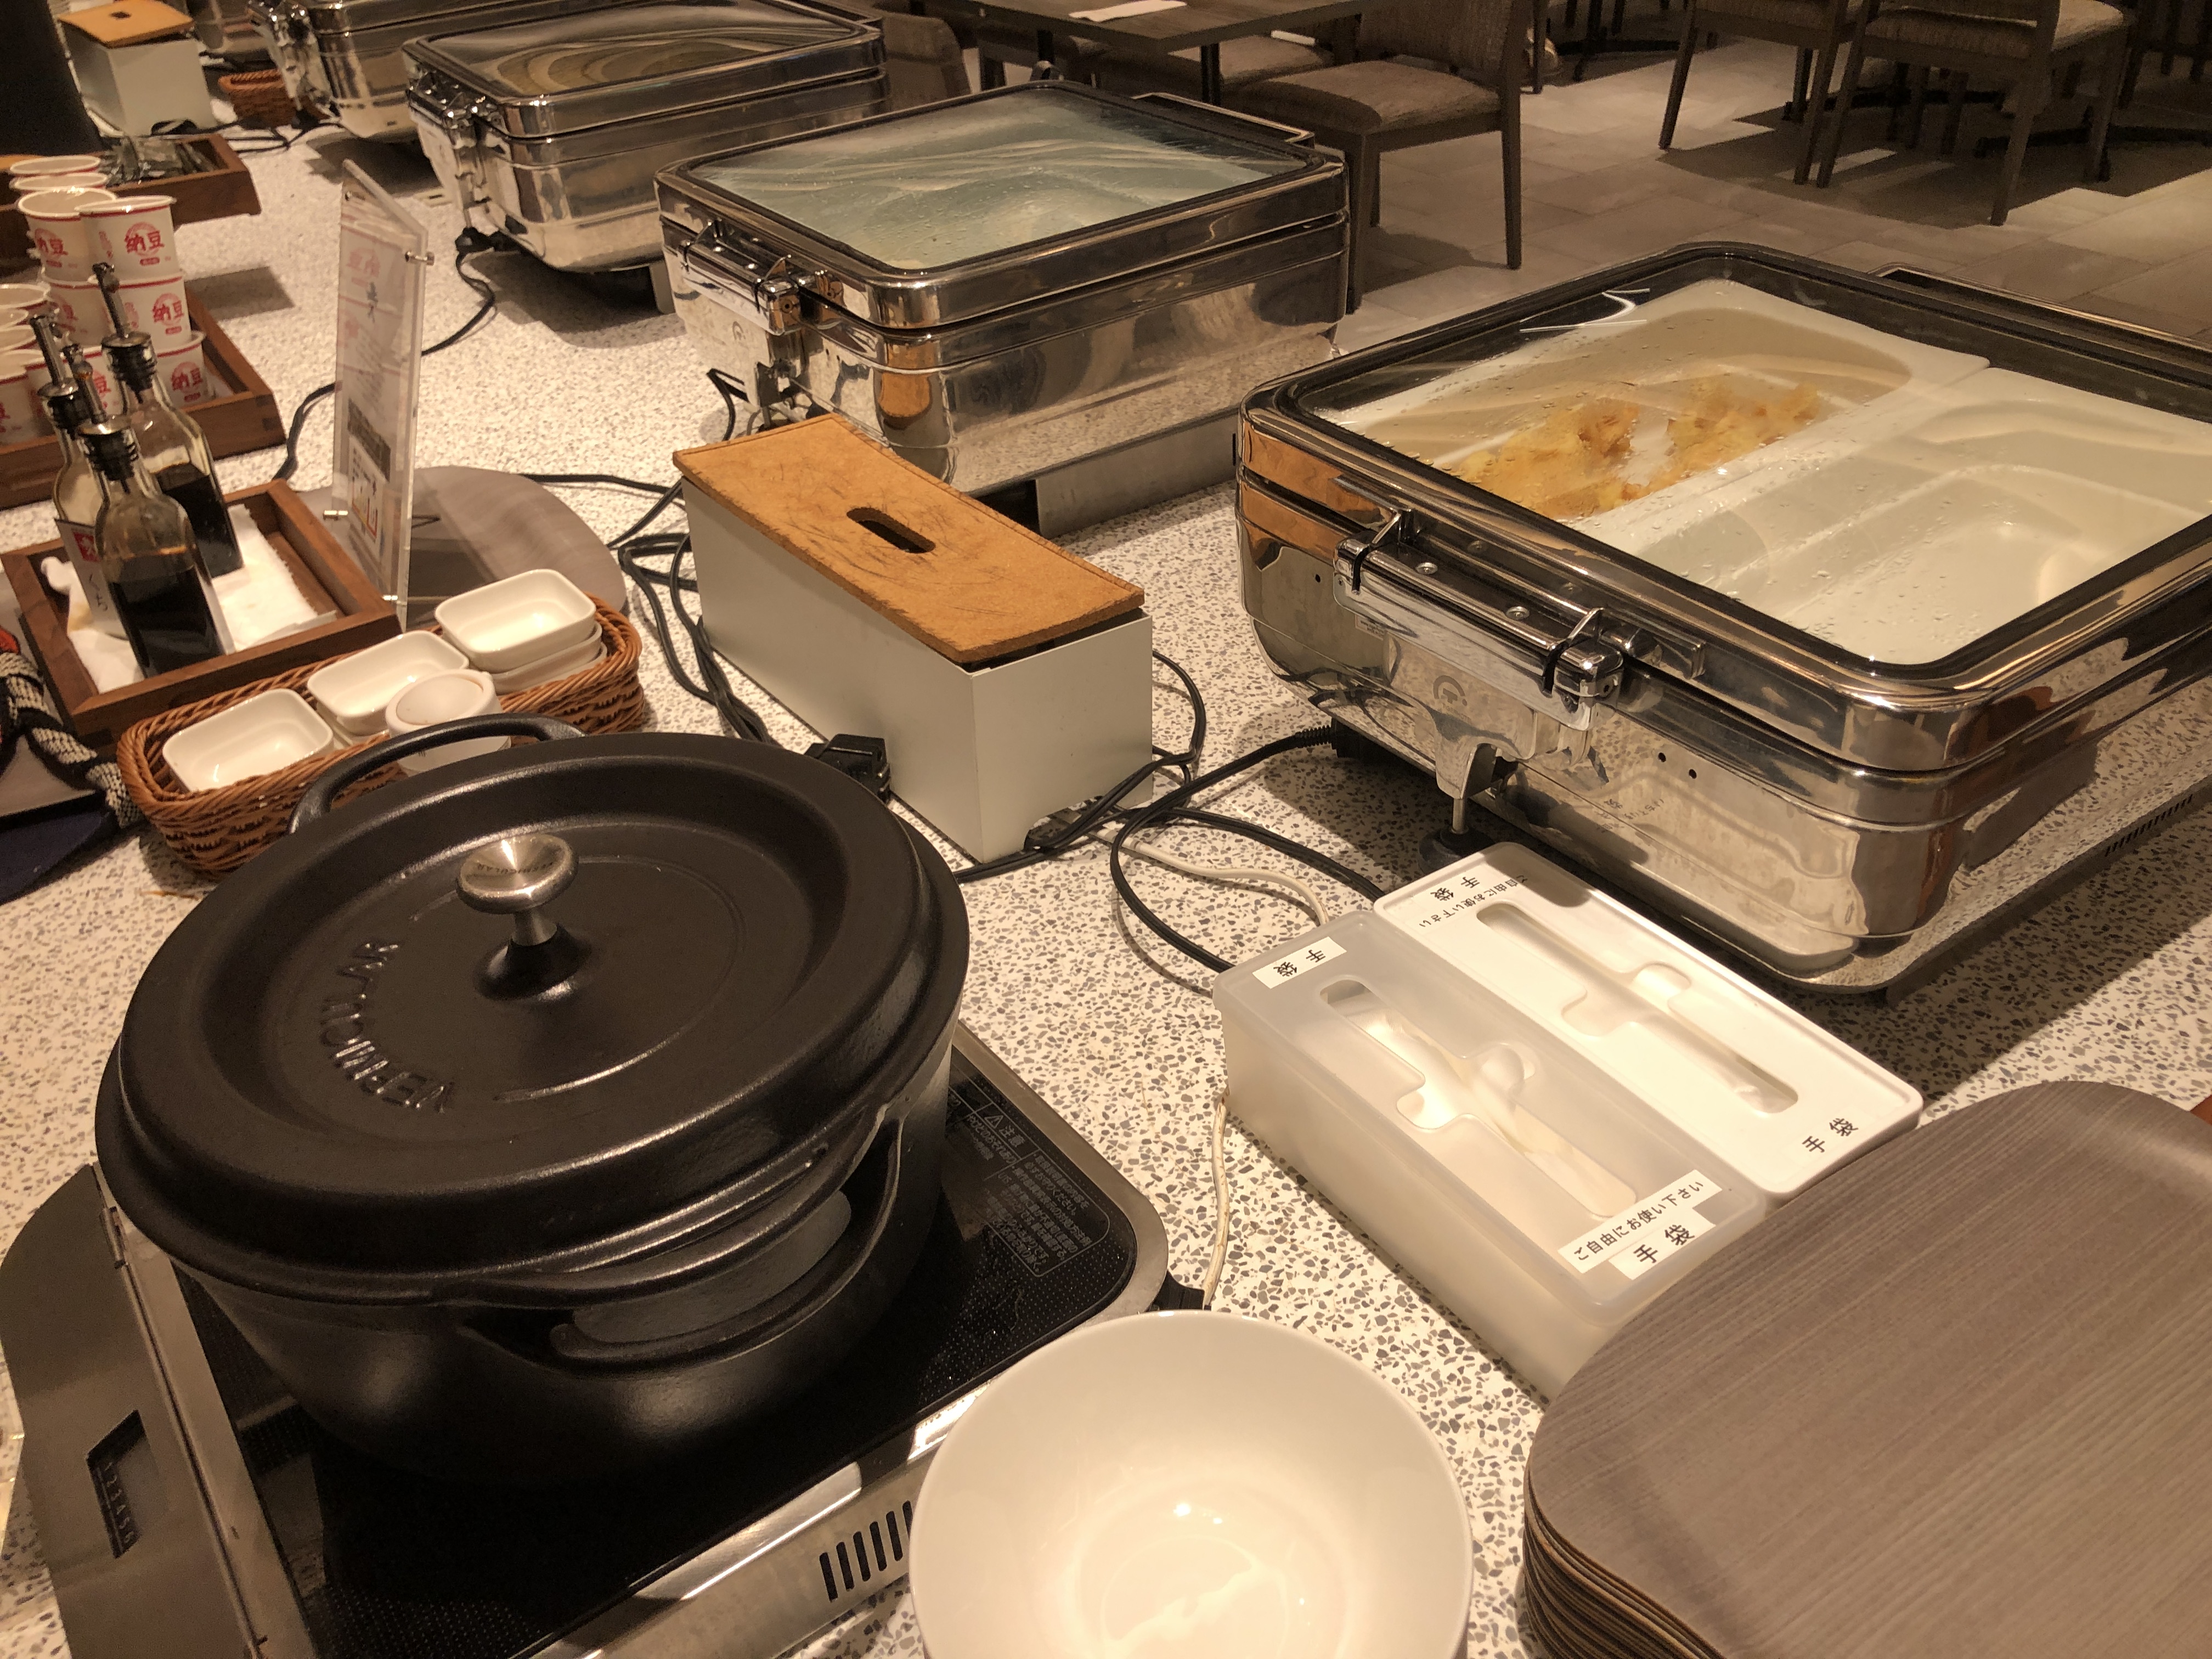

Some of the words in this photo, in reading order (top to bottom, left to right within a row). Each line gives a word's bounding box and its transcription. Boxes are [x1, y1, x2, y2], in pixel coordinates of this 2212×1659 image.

[123, 230, 165, 253] 納豆
[152, 301, 184, 323] 納豆
[1430, 876, 1480, 901] 手袋
[1273, 950, 1326, 977] 手袋
[1802, 1117, 1859, 1153] 手袋
[1573, 1180, 1704, 1261] ご自由にお使い下さい
[1633, 1224, 1695, 1264] 手袋
